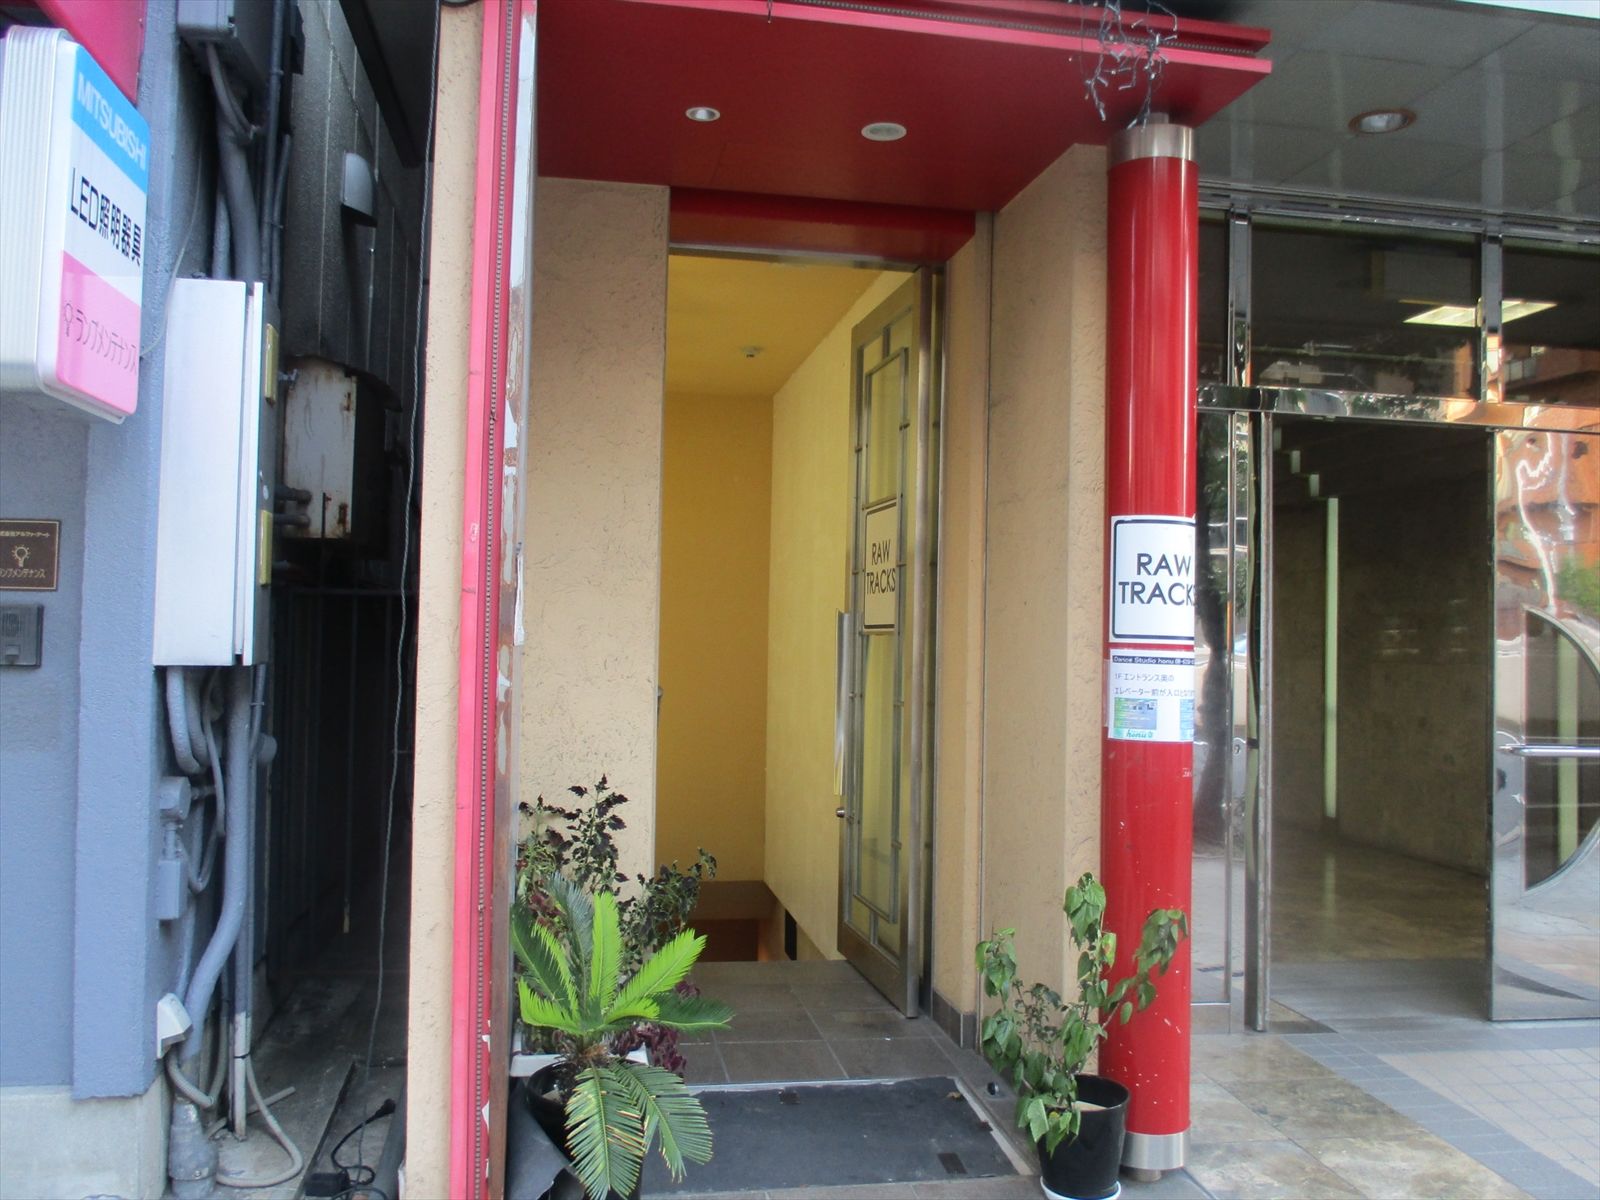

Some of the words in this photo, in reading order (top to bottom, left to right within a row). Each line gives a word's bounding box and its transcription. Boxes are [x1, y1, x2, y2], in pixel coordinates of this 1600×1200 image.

[78, 71, 147, 171] MITSUBISHI
[71, 167, 141, 266] LED照明器具
[75, 308, 137, 375] ランプメンテナンス
[872, 539, 891, 566] RAW
[1136, 553, 1191, 576] RAW
[866, 567, 896, 595] TRACKS
[1118, 581, 1195, 606] TRACK
